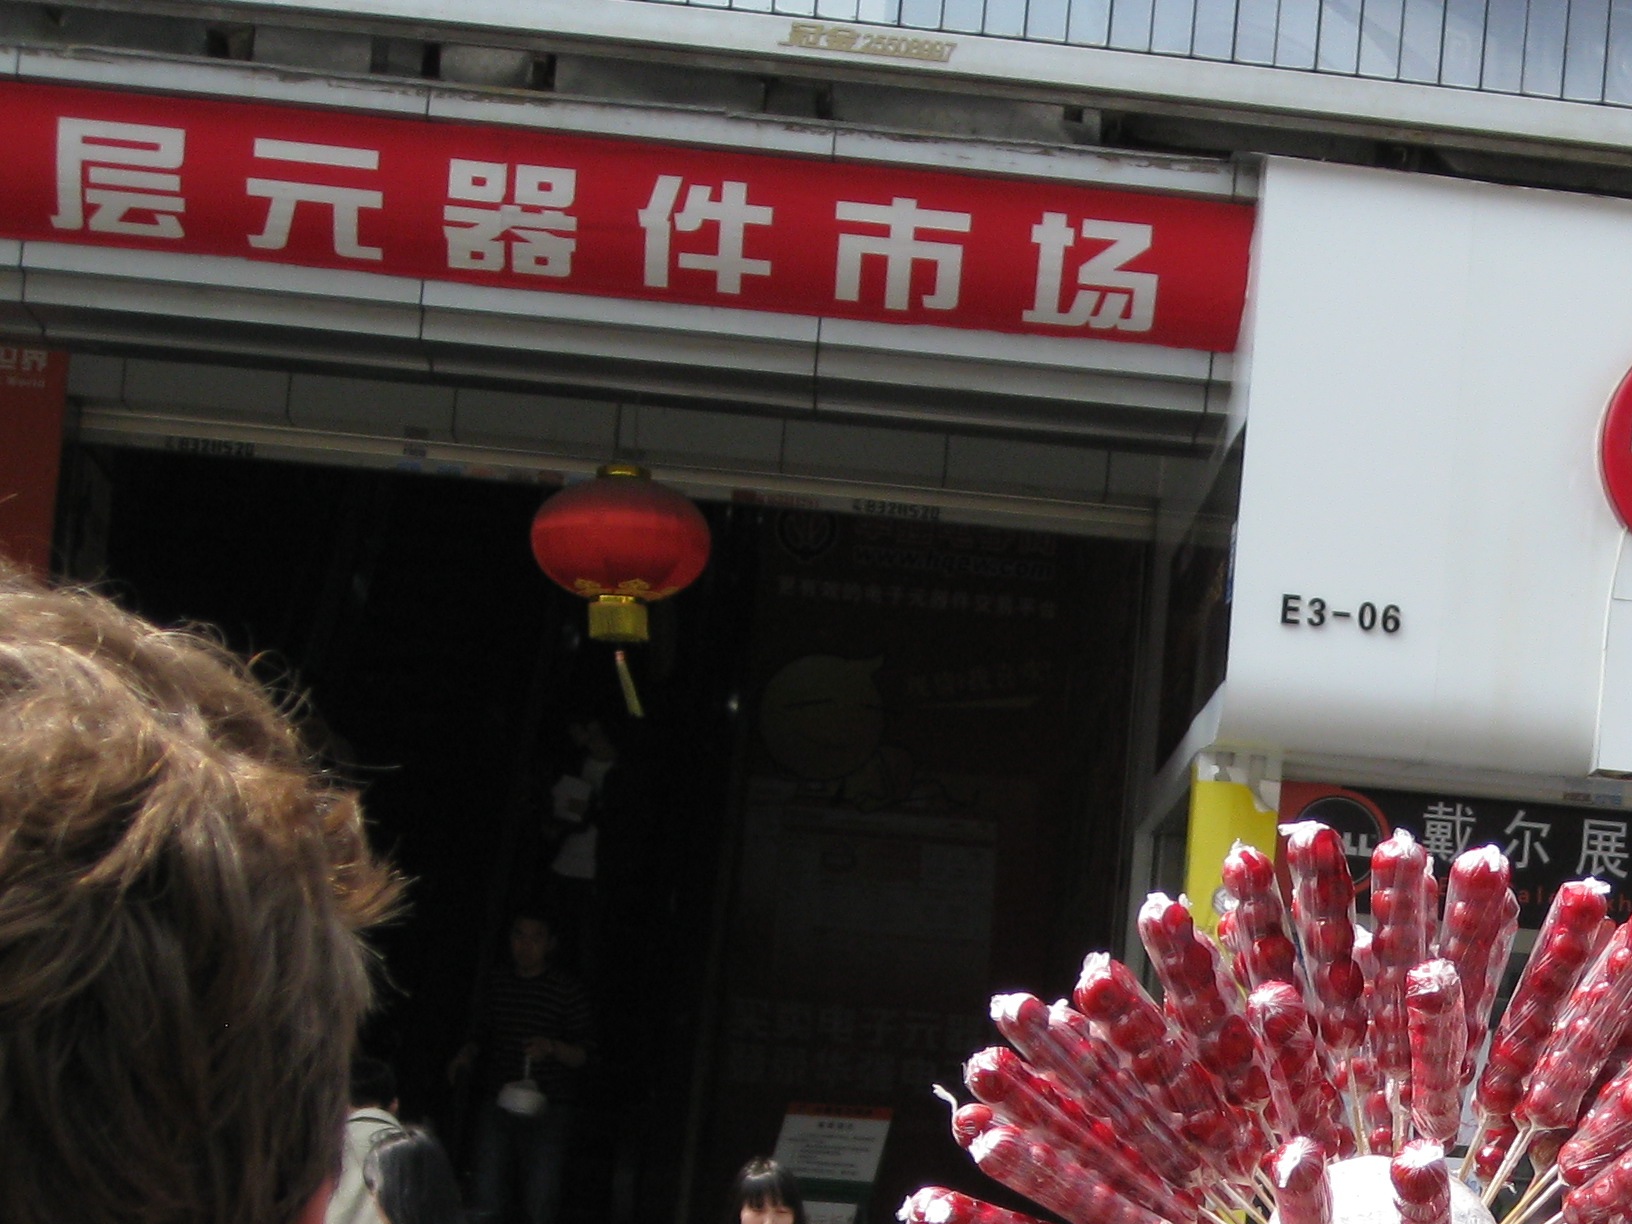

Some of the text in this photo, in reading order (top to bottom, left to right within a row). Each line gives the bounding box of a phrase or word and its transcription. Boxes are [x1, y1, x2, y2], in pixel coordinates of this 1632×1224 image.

[50, 116, 1159, 334] 层元器件市场
[1281, 594, 1401, 633] E3-06
